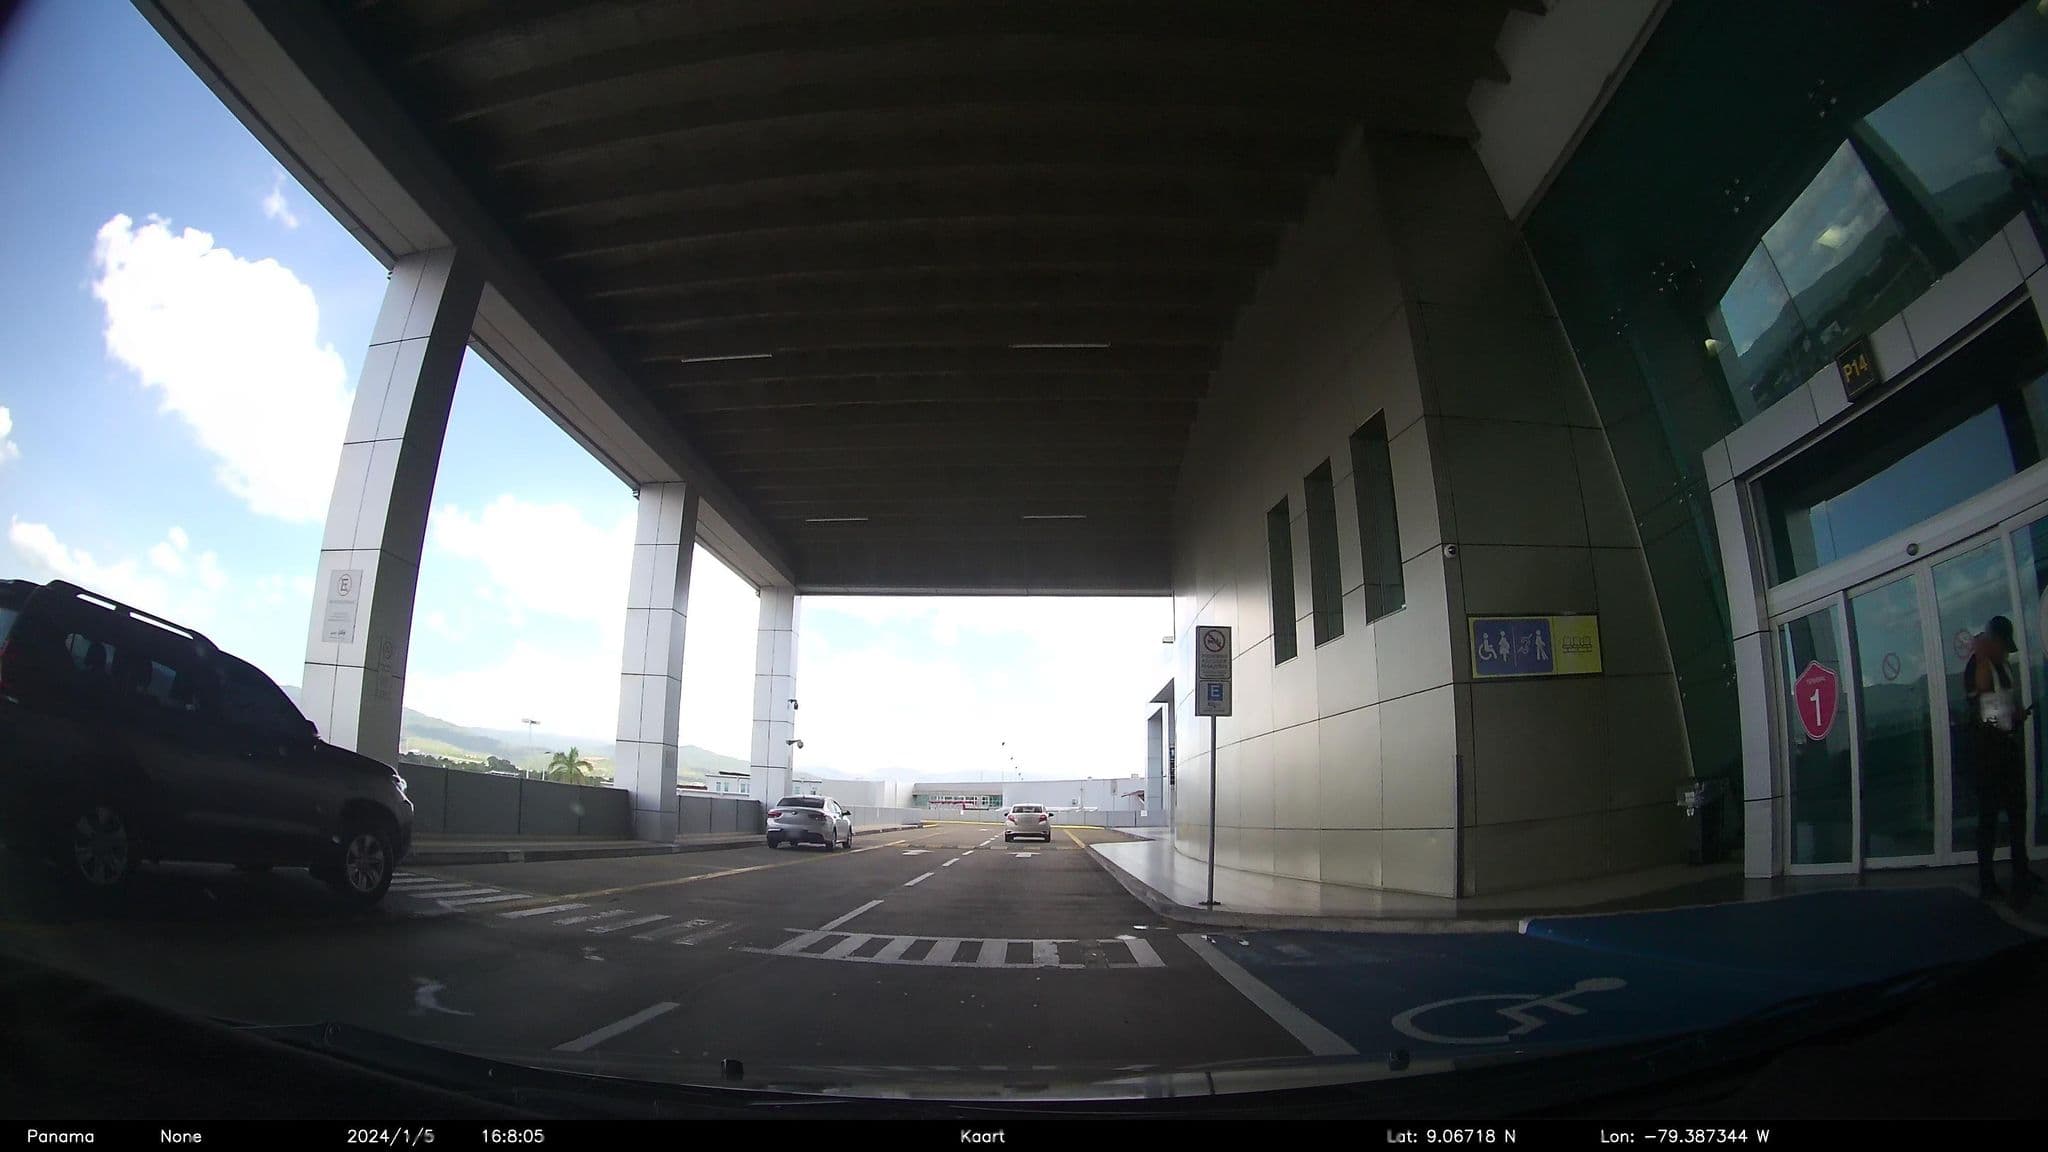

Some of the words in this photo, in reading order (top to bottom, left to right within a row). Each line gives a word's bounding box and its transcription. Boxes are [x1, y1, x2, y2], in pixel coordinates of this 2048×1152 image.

[1843, 354, 1869, 383] P14
[340, 578, 349, 591] E
[1210, 685, 1220, 697] E
[1810, 688, 1822, 726] 1
